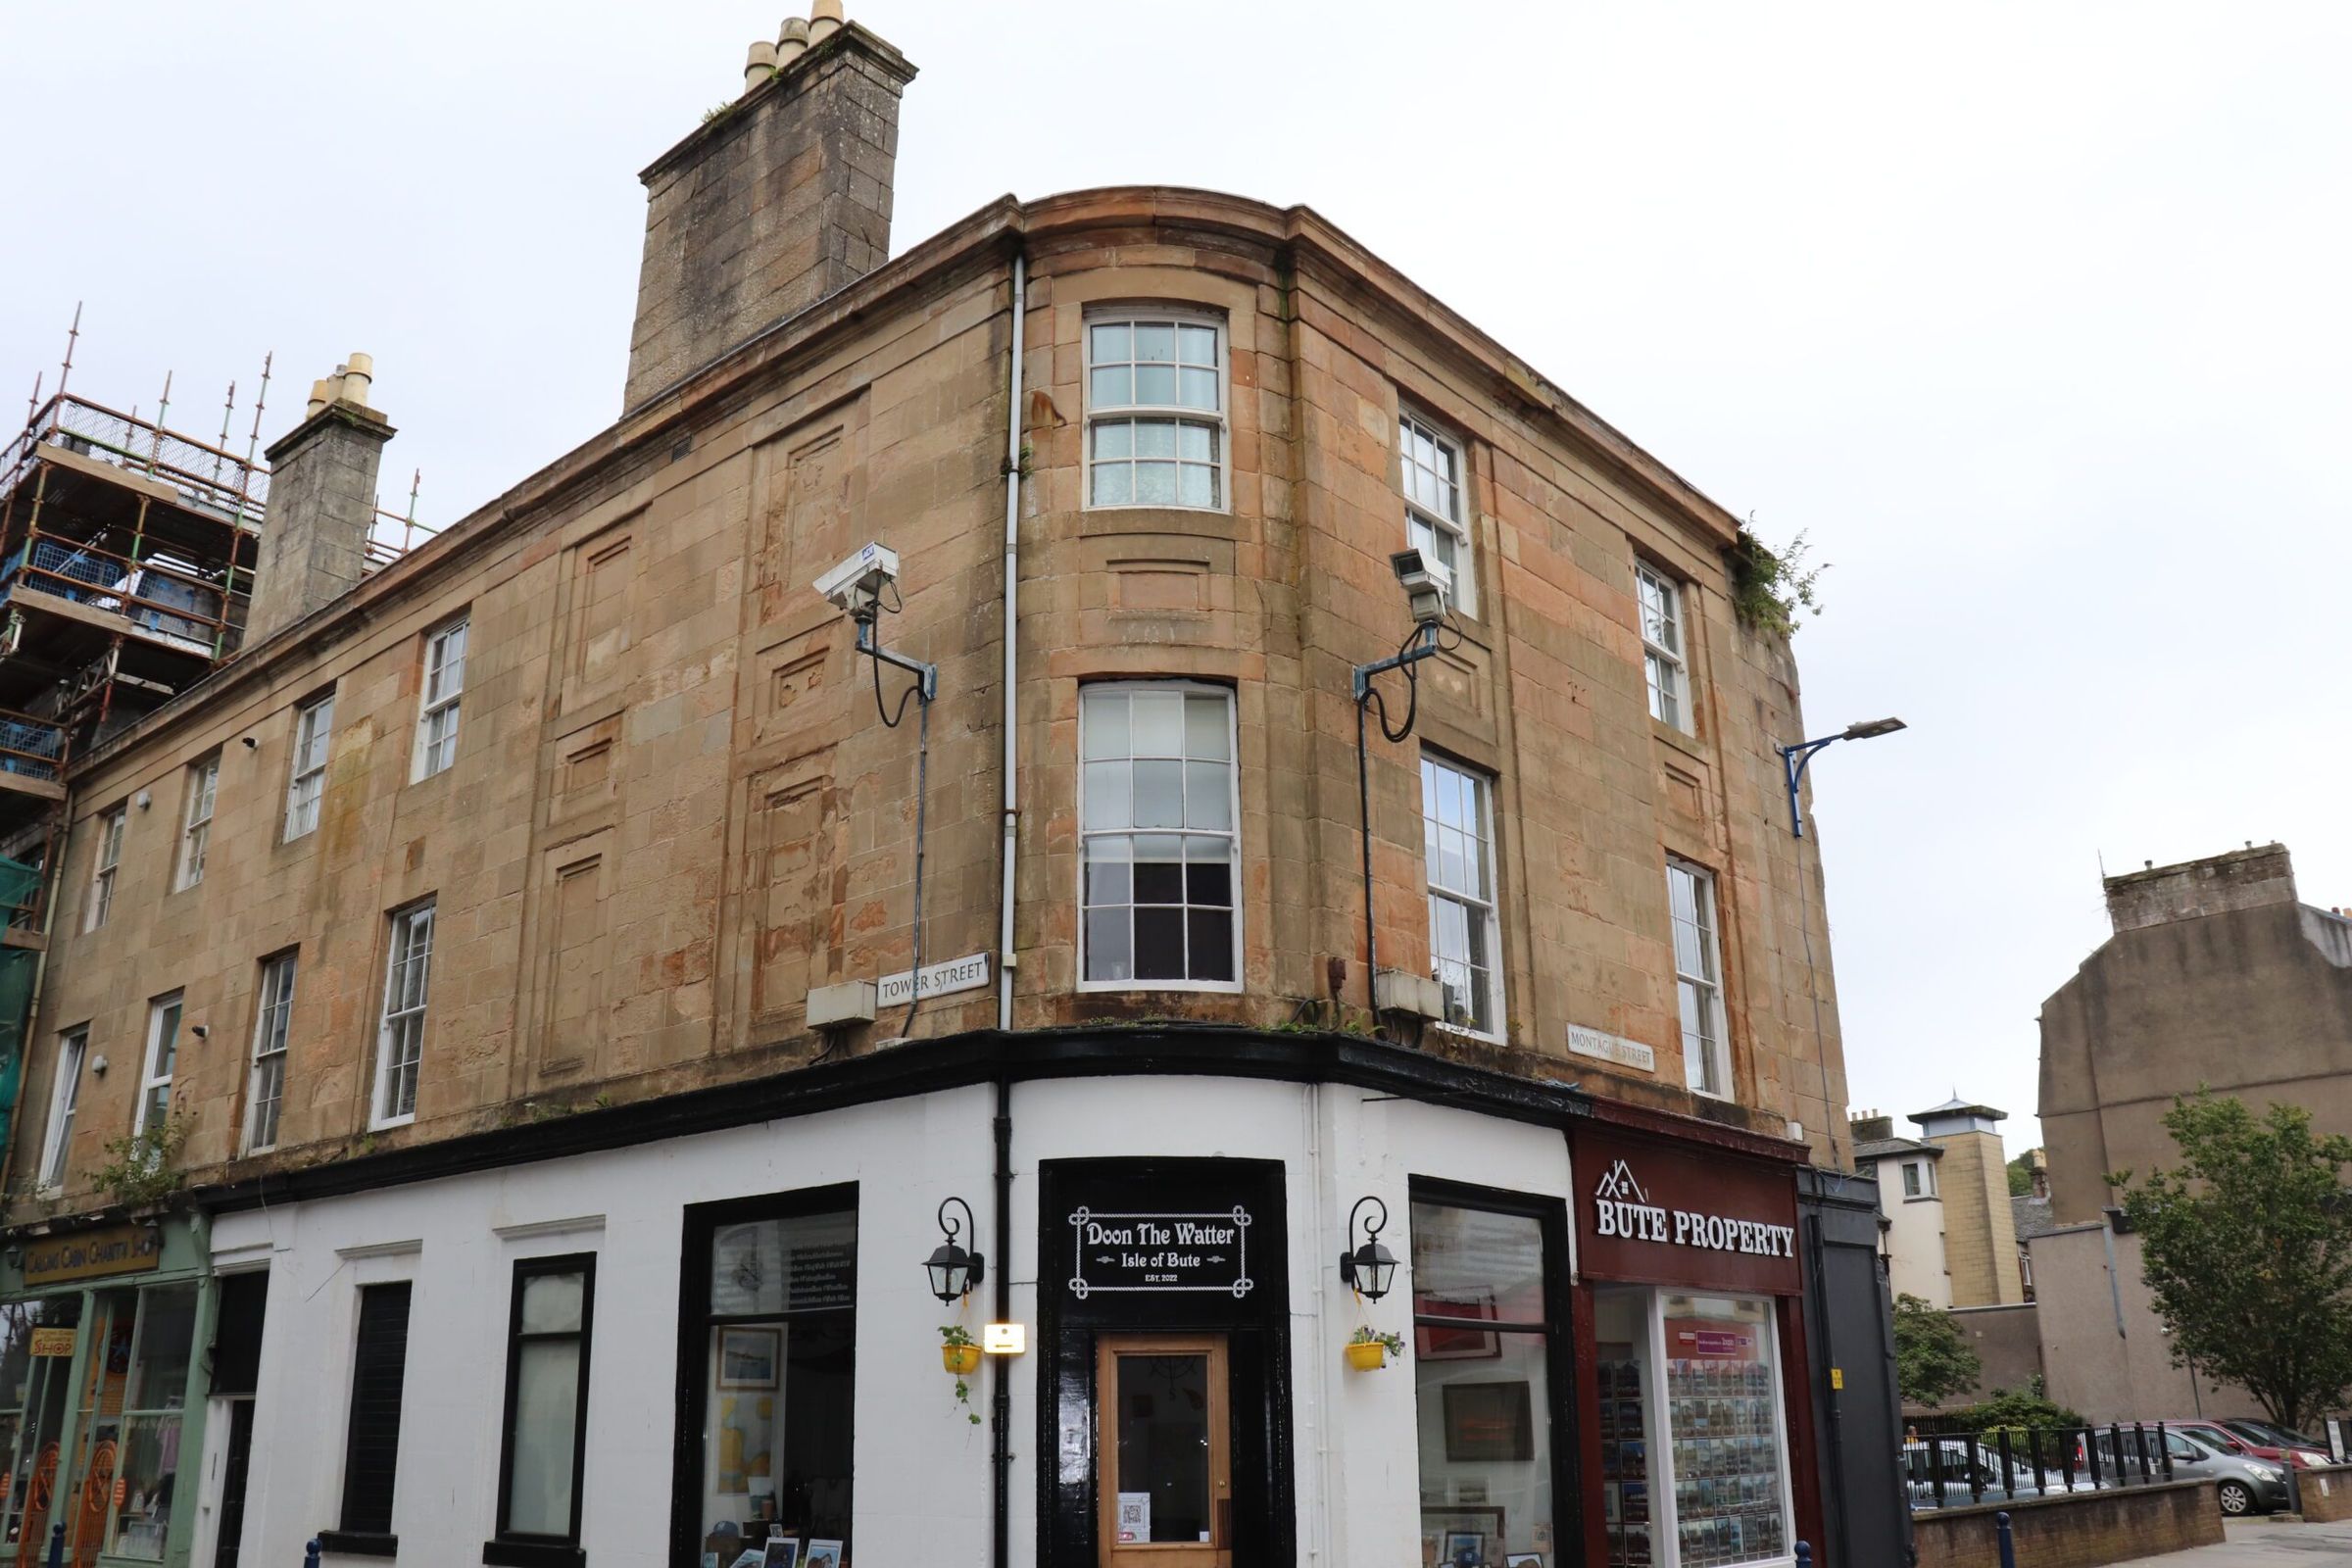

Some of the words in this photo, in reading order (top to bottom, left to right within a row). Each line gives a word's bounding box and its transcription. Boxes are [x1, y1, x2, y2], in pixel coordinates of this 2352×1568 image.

[934, 961, 983, 987] STREET
[1622, 1045, 1651, 1064] STREET
[1086, 1222, 1133, 1245] Doon
[1136, 1222, 1170, 1245] The
[1174, 1222, 1235, 1245] Watter
[1595, 1199, 1667, 1243] BUTE
[1673, 1210, 1794, 1258] PROPERTY
[1121, 1252, 1147, 1267] Isle
[1150, 1252, 1164, 1267] of
[1167, 1252, 1200, 1267] Bute
